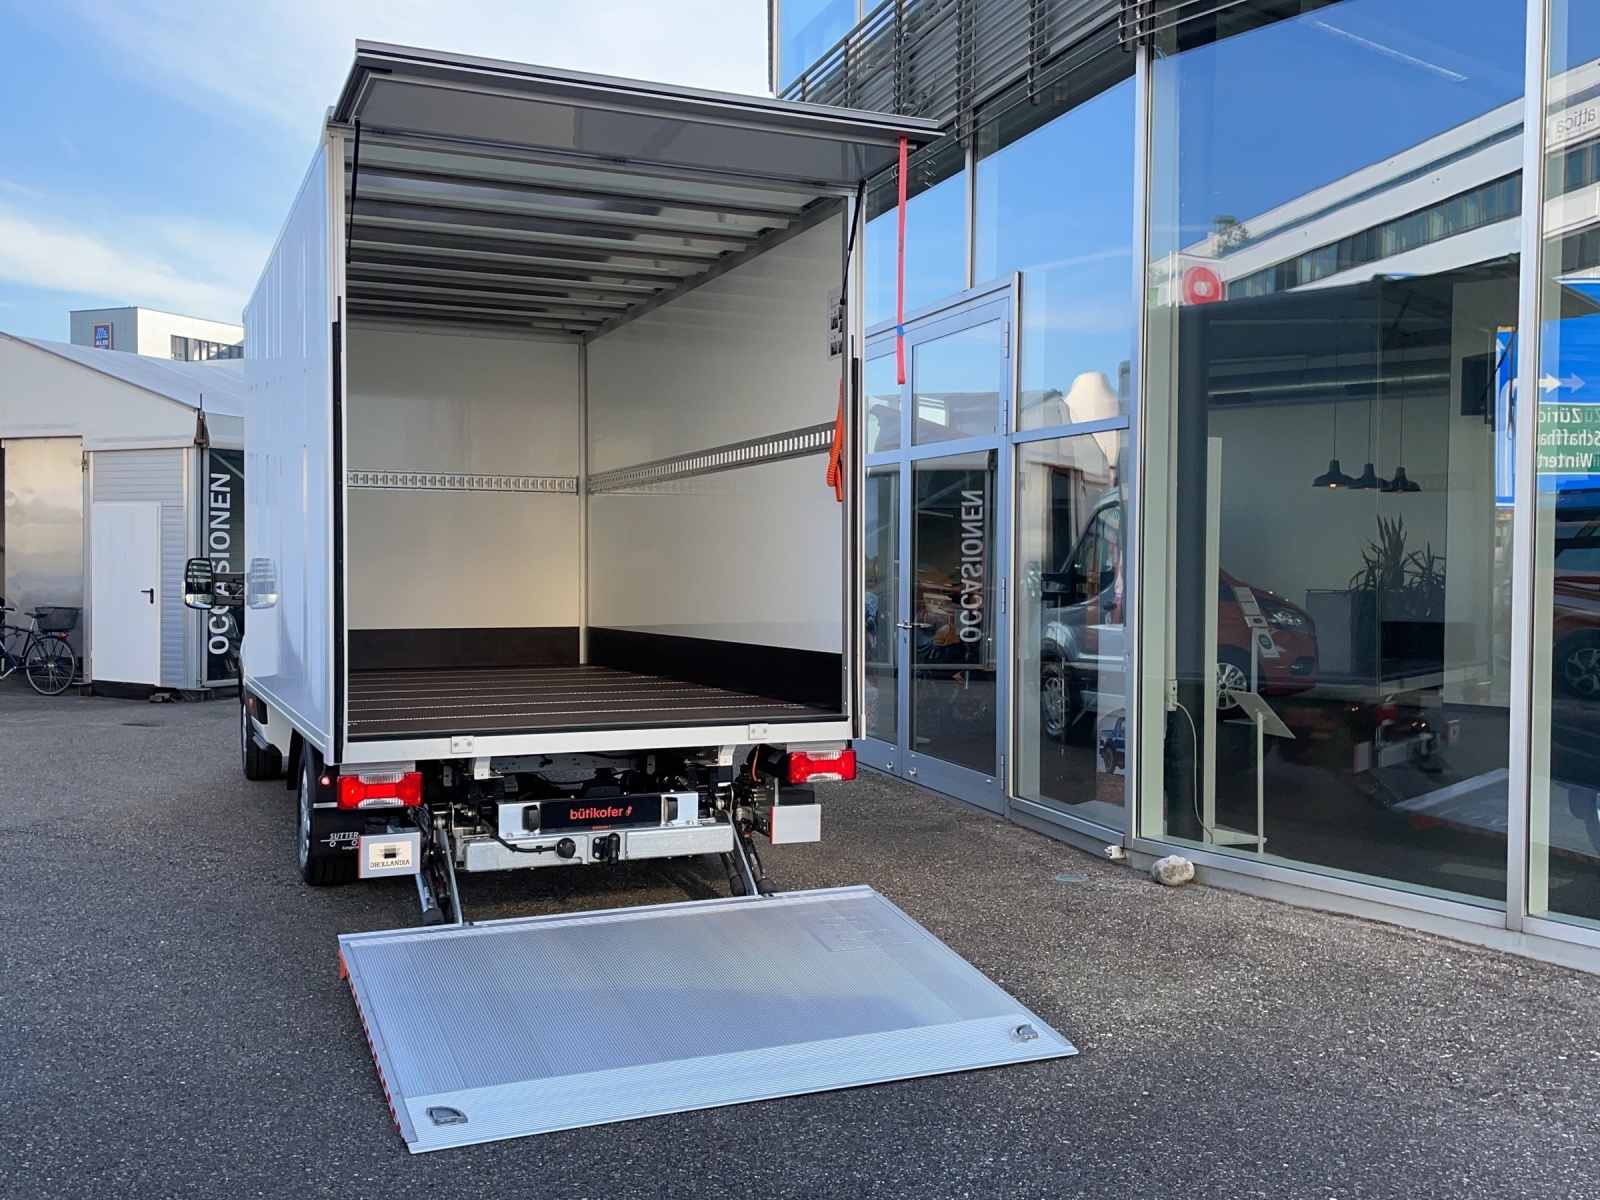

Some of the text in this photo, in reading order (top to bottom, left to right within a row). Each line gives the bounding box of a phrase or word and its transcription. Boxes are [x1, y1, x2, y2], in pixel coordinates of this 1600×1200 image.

[569, 806, 624, 820] bütikofer
[330, 832, 359, 840] SUTTER
[370, 859, 410, 868] DHOLLANDIA
